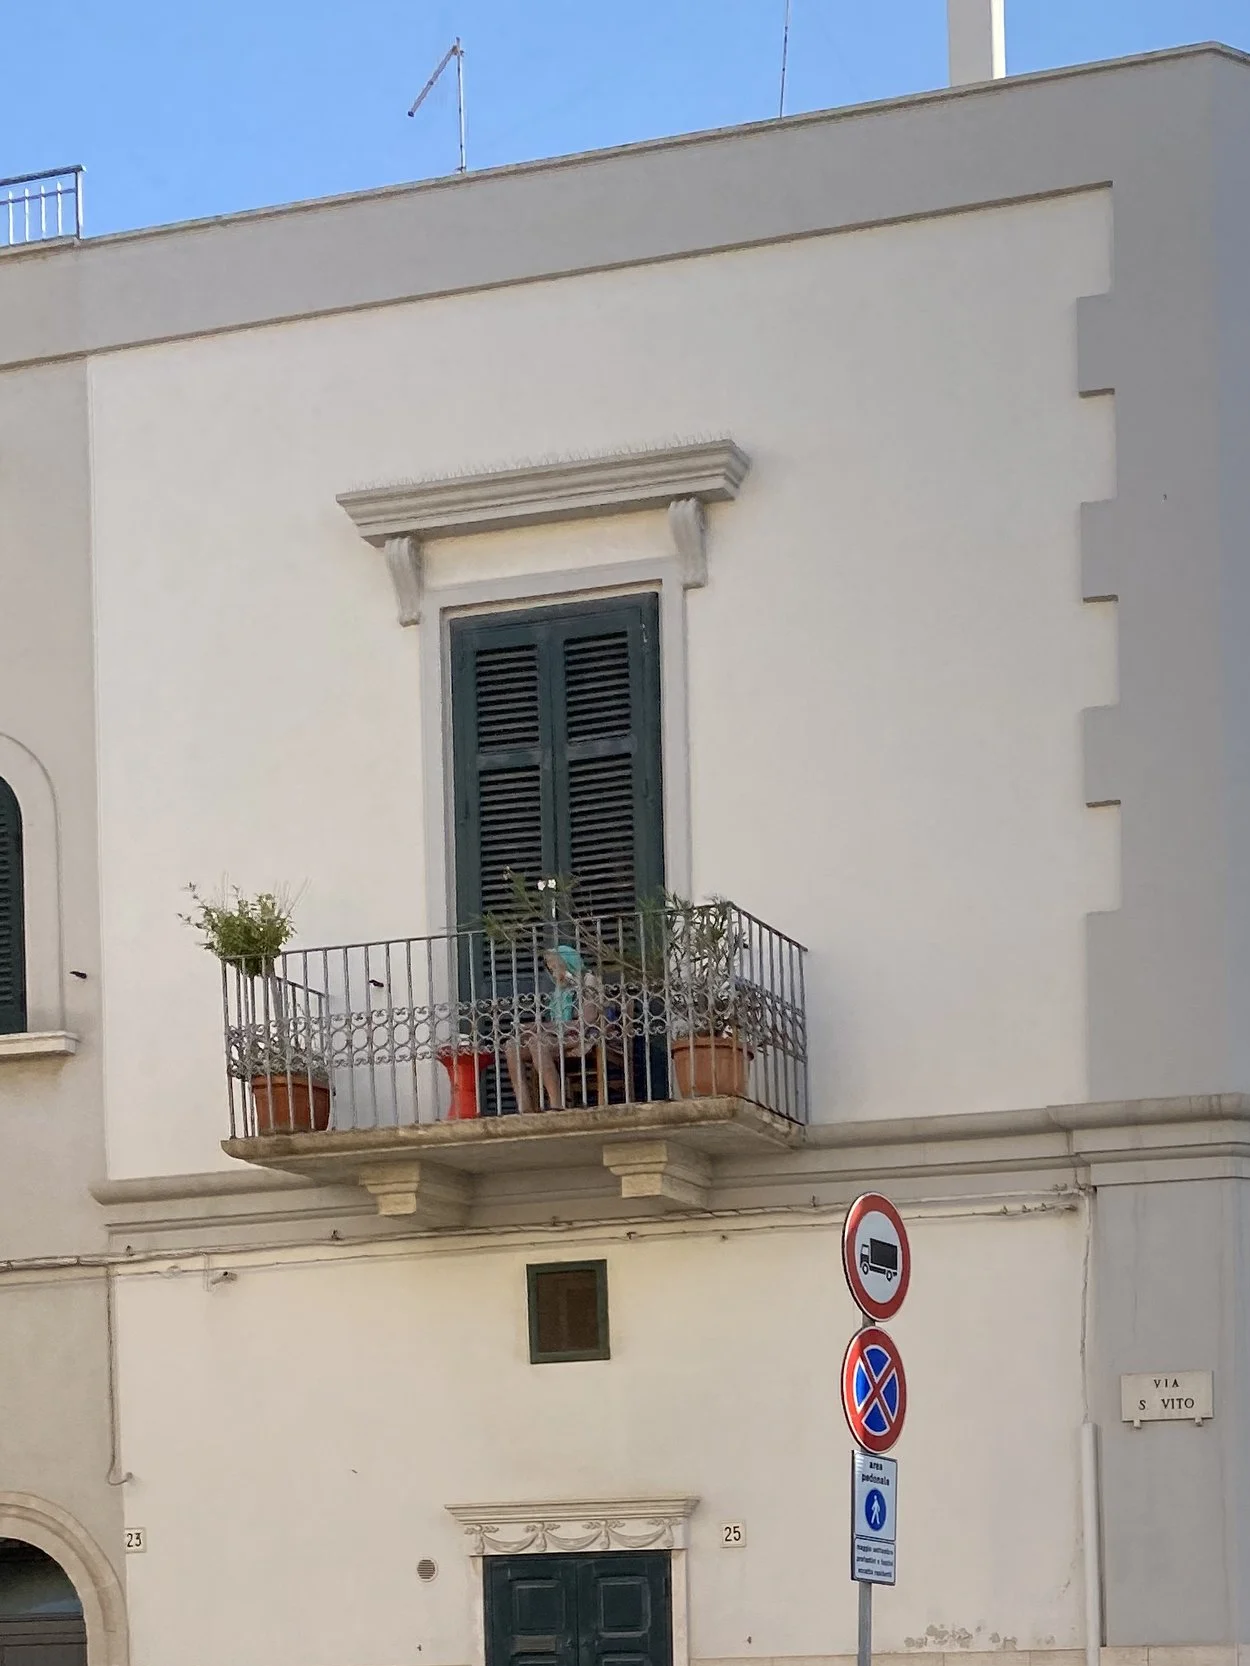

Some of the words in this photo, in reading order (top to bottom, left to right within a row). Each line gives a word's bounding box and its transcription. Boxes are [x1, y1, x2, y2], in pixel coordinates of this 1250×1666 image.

[1153, 1379, 1180, 1389] VIA
[1138, 1400, 1147, 1411] S
[1161, 1398, 1195, 1410] VITO
[869, 1462, 883, 1471] area
[127, 1532, 142, 1547] 23
[724, 1526, 741, 1542] 25
